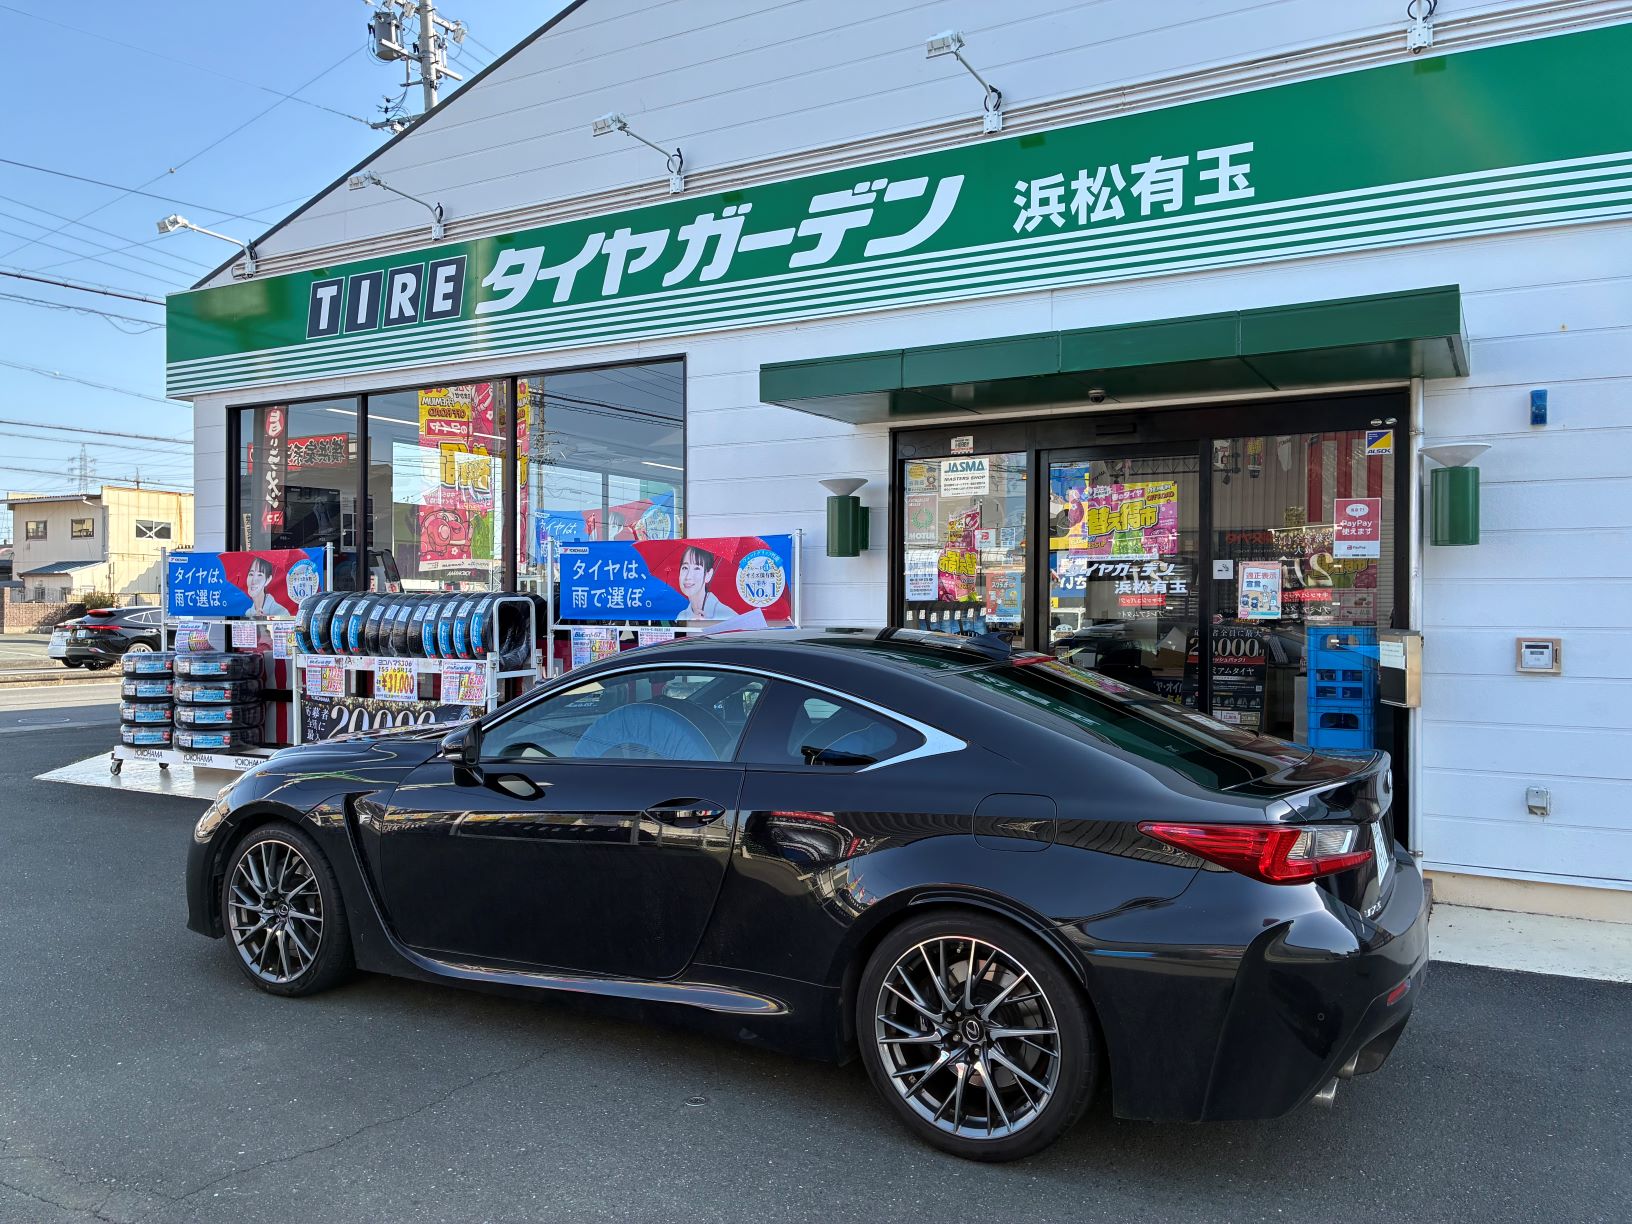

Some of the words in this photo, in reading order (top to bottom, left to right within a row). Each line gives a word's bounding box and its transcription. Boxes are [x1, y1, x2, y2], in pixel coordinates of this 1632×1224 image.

[317, 265, 456, 329] TIRE
[475, 174, 965, 314] タイヤガーデン
[1013, 141, 1256, 233] 浜松有玉
[944, 460, 984, 473] JASMA
[1087, 500, 1158, 536] 替え得市
[1342, 528, 1373, 536] 使えます
[174, 567, 223, 584] タイヤは、
[572, 559, 648, 580] タイヤは、
[745, 582, 776, 598] No.1
[1115, 580, 1187, 594] 浜松有玉
[174, 589, 227, 607] 雨で選ぼ。
[572, 586, 652, 609] 雨で選ぼ。
[134, 750, 163, 758] YOKOHAMA
[184, 754, 214, 763] YOKOHAMA
[235, 758, 264, 766] YOKOHA
